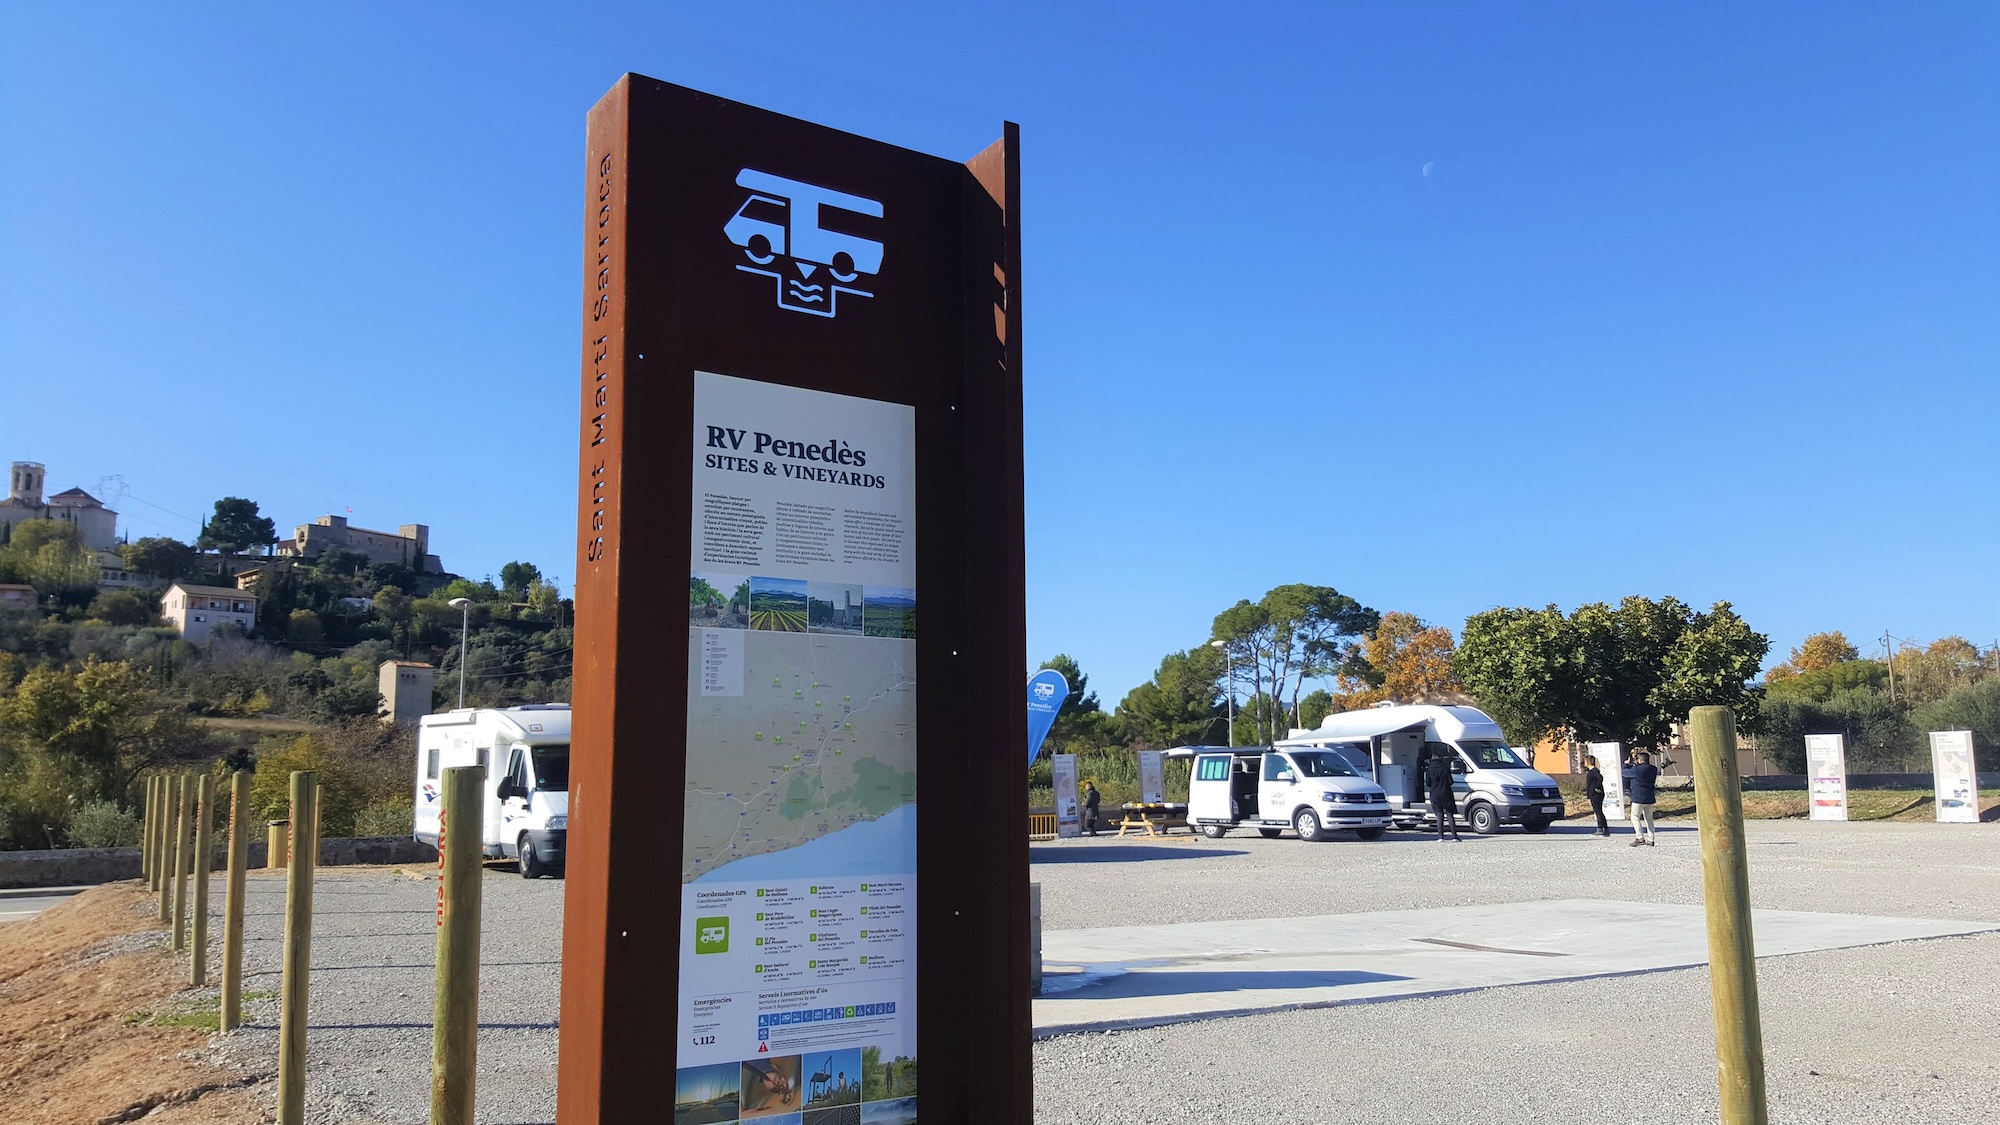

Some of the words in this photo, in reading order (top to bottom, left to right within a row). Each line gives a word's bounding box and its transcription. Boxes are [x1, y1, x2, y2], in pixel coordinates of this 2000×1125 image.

[593, 153, 611, 323] Sarroca
[706, 425, 747, 450] RV
[753, 432, 866, 466] Penedès
[705, 454, 758, 473] SITES
[763, 461, 778, 476] &
[782, 463, 885, 489] VINEYARDS
[588, 460, 604, 562] Sant
[694, 997, 732, 1006] Emergències
[758, 991, 779, 999] Serveis
[783, 989, 815, 997] normatives
[700, 1036, 716, 1045] 112
